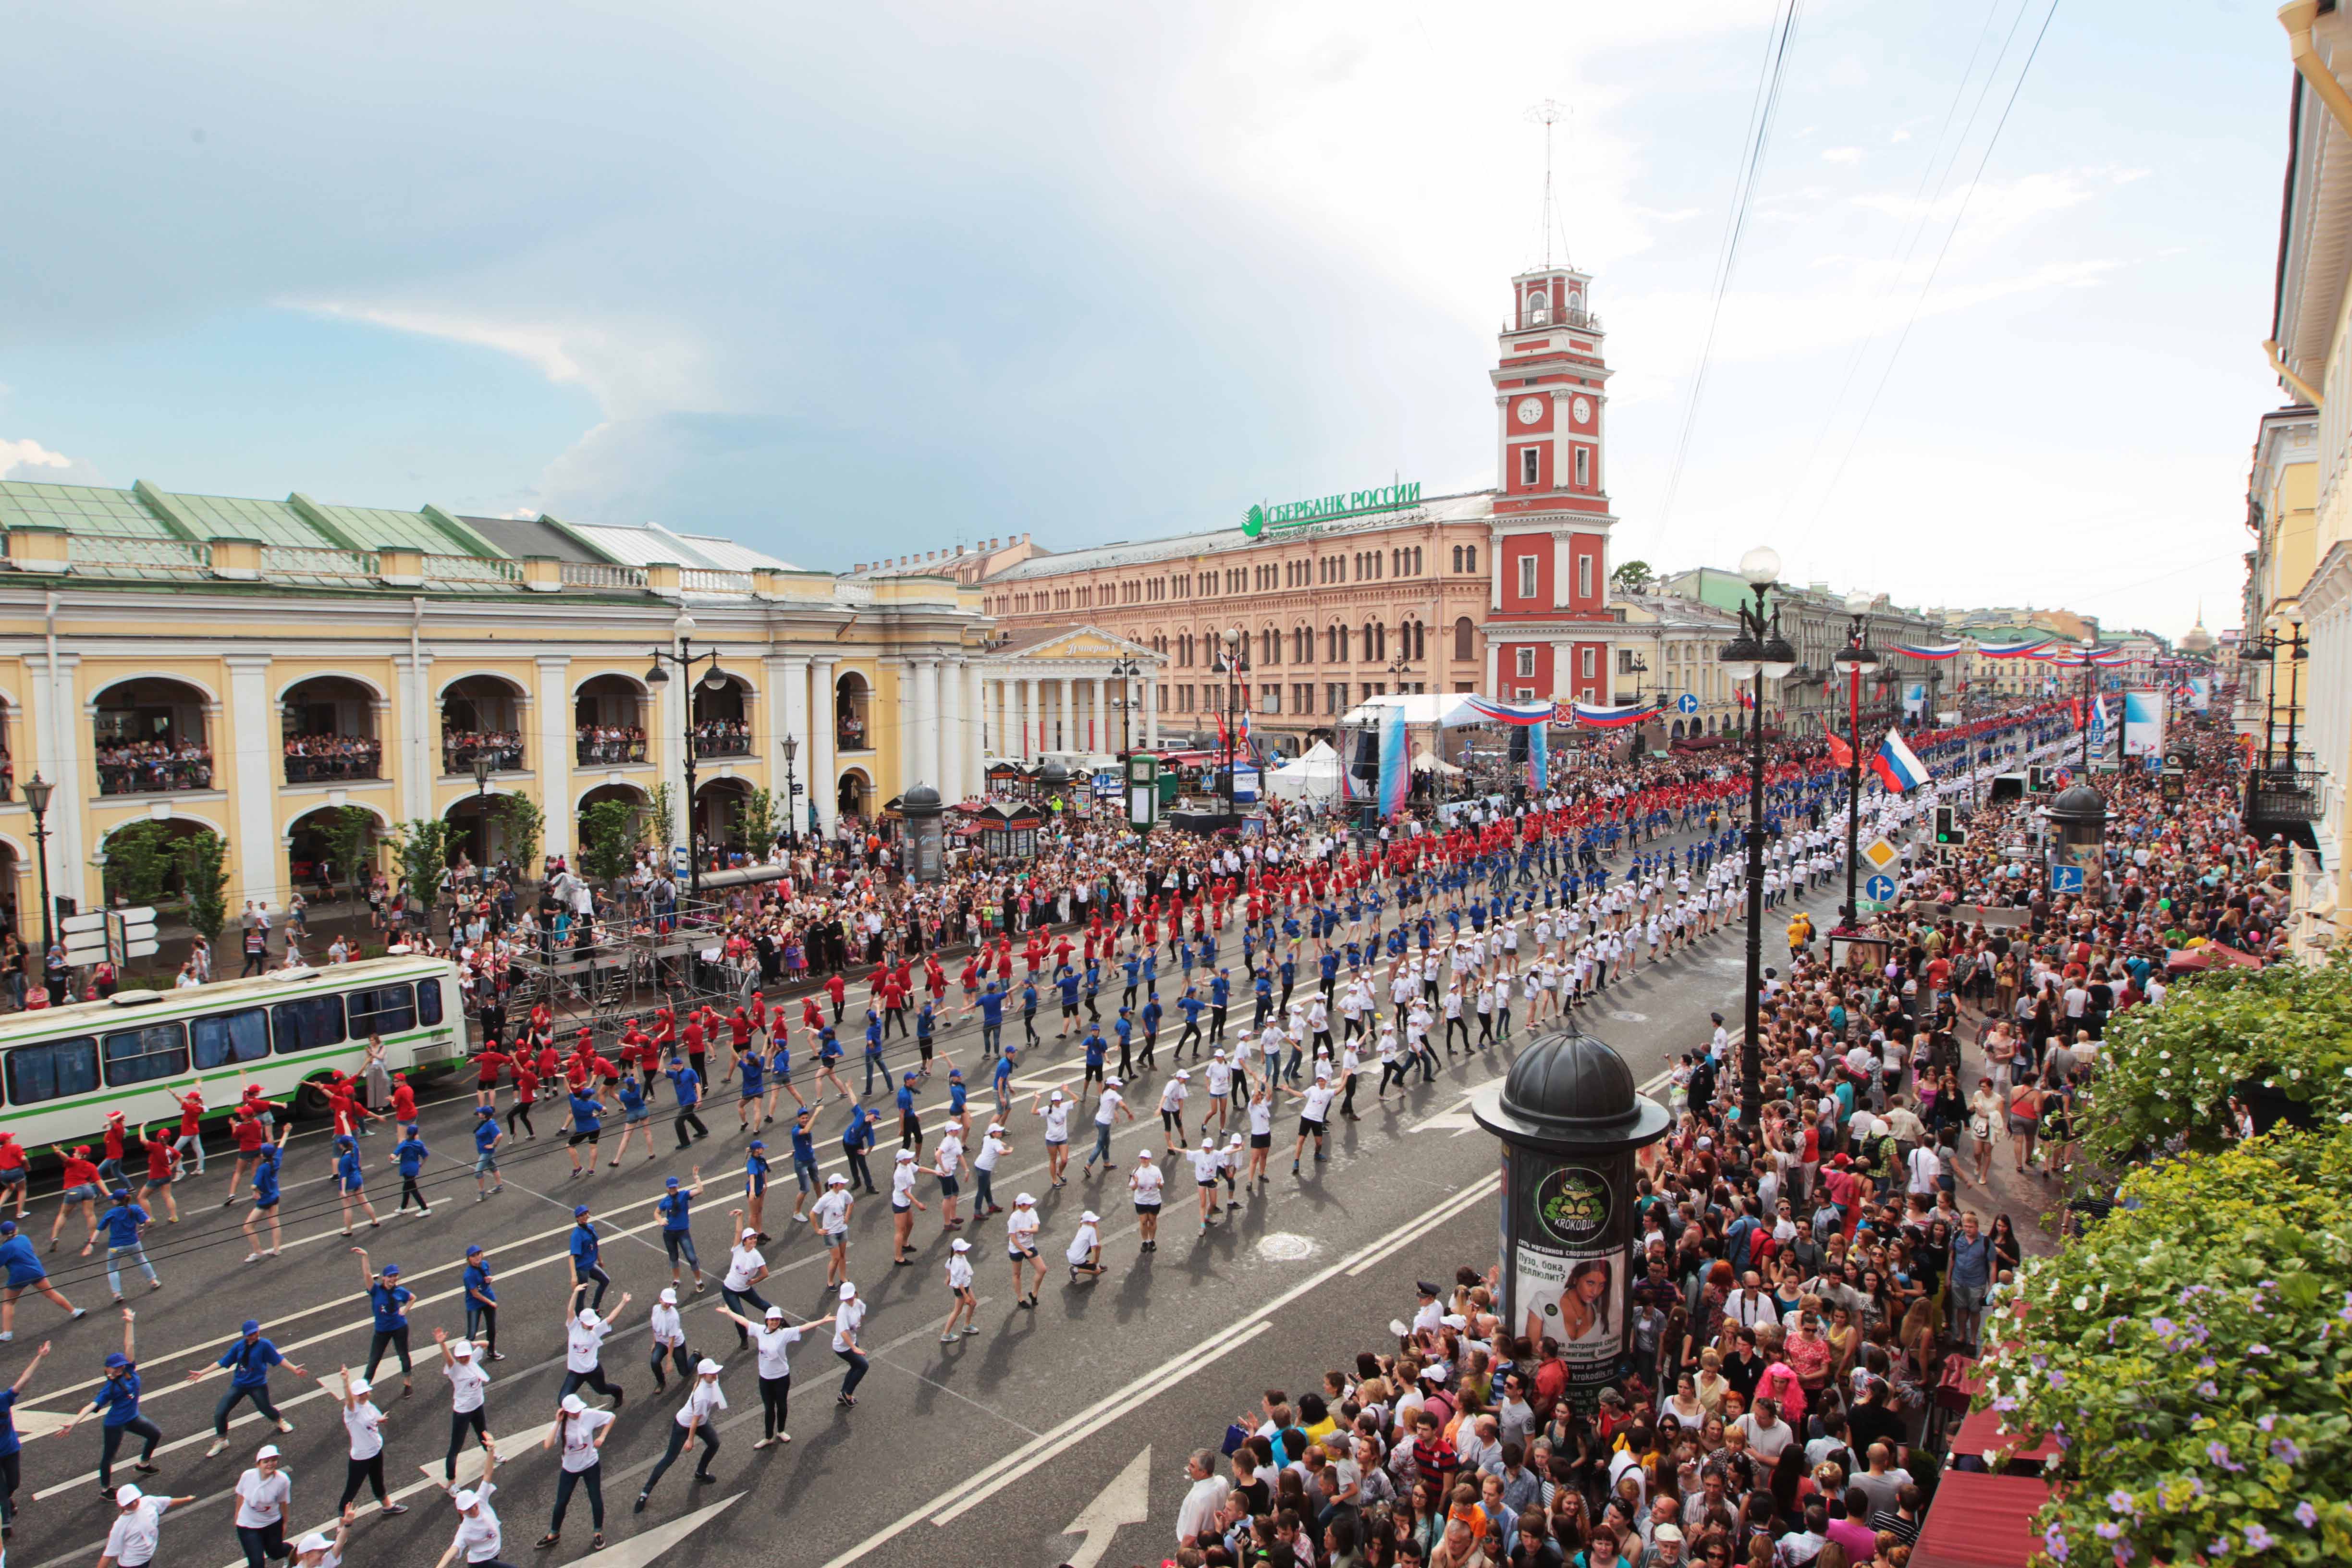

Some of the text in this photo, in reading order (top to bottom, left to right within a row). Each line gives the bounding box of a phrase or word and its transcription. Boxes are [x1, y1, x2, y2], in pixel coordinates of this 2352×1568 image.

[1267, 481, 1421, 525] СБЕРБАНК РОССИИ
[1065, 643, 1115, 657] Империал
[1555, 1218, 1595, 1231] KROKODIL
[1519, 1239, 1530, 1248] сеть
[1531, 1244, 1563, 1255] магазинов
[1565, 1249, 1604, 1257] спортивного
[1519, 1252, 1566, 1274] Пузо, бока,
[1518, 1264, 1565, 1282] целлюлит?
[1572, 1368, 1614, 1382] krokodils.ru
